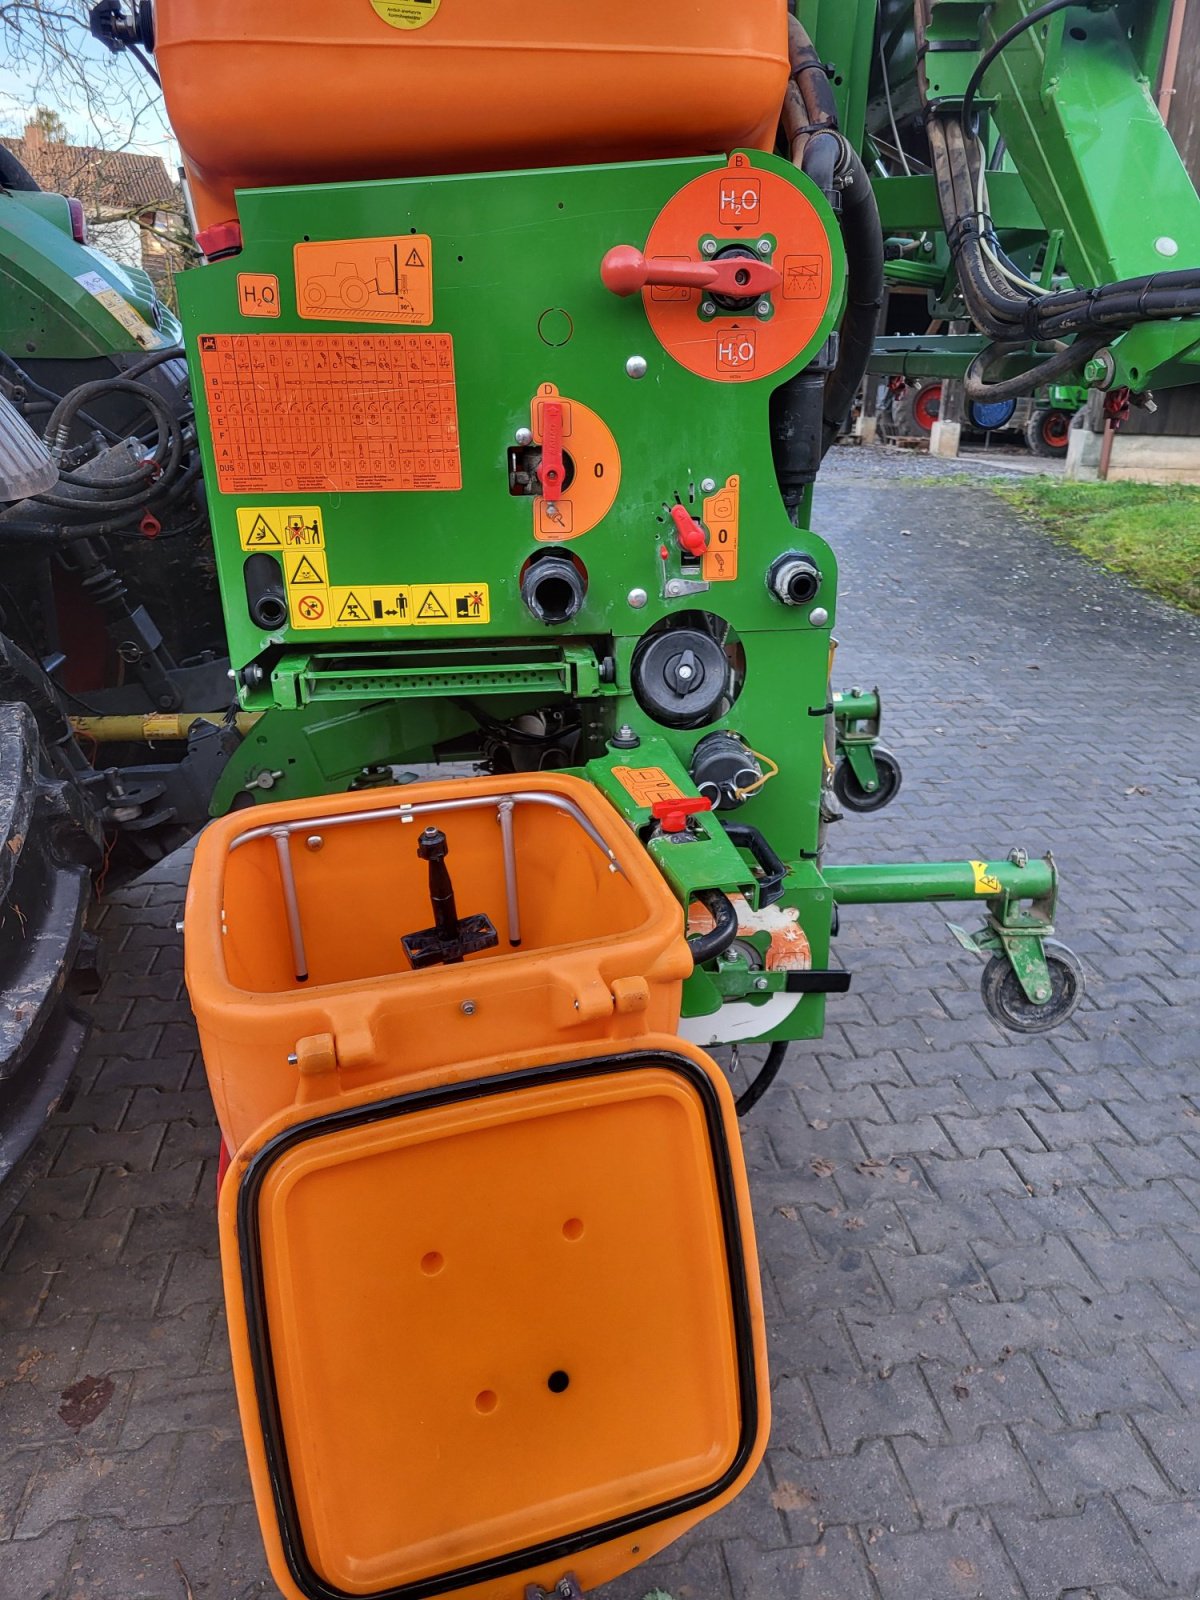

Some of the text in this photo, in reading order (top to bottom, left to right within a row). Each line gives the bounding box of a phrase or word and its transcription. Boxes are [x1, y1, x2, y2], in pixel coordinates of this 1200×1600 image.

[736, 156, 742, 166] B
[721, 190, 758, 214] H2O
[719, 342, 753, 365] H2O
[545, 384, 552, 394] D
[594, 462, 604, 478] 0
[730, 478, 737, 488] C
[718, 529, 728, 544] 0
